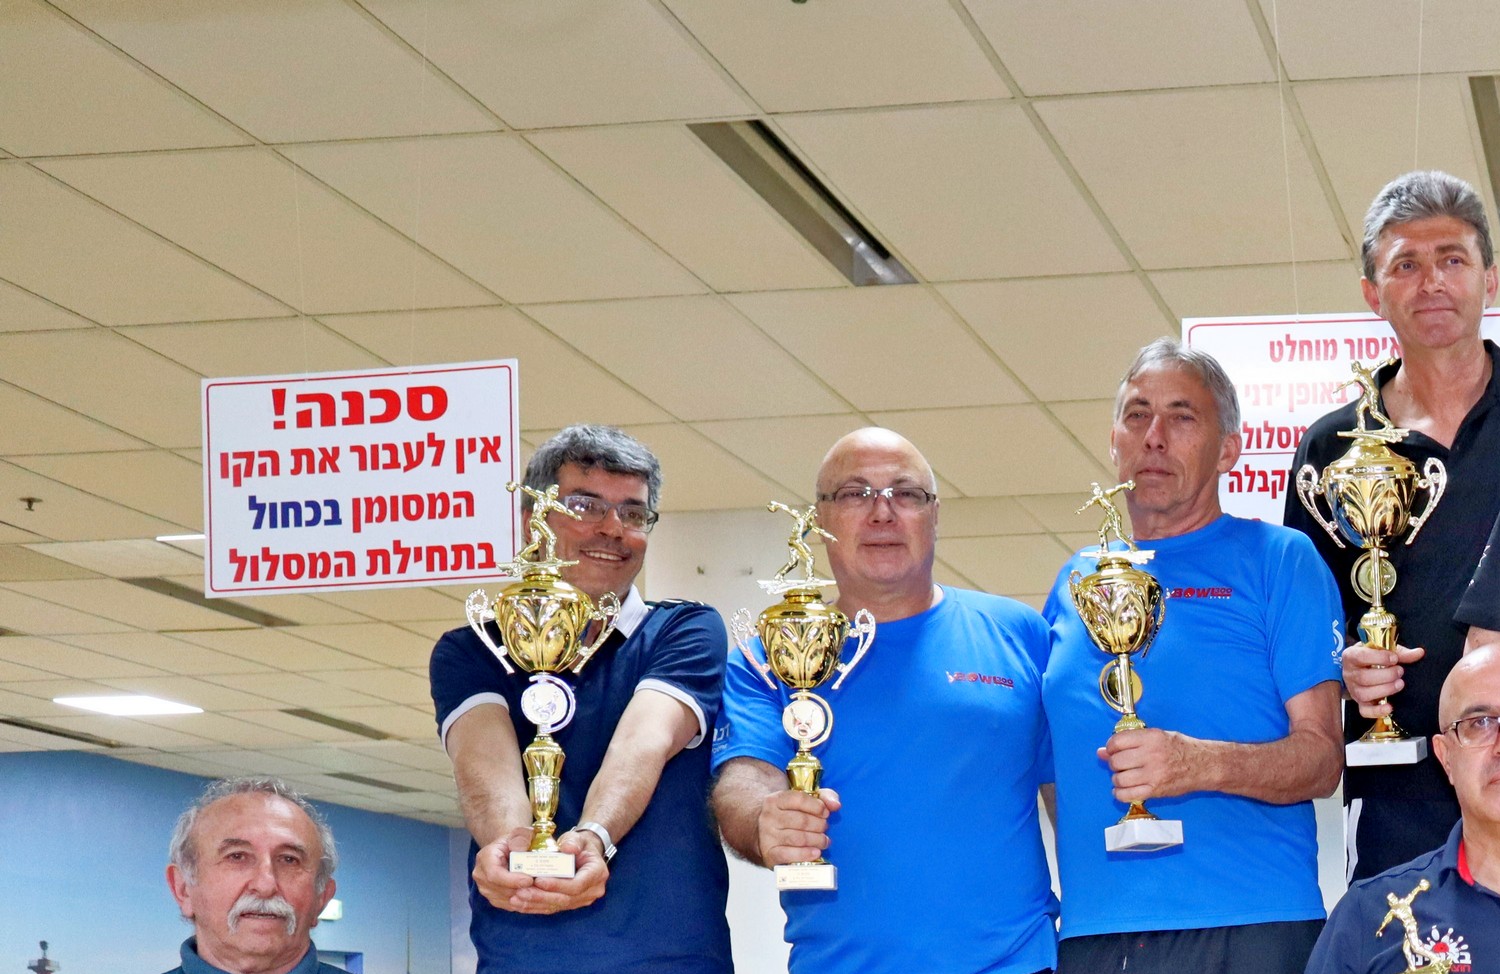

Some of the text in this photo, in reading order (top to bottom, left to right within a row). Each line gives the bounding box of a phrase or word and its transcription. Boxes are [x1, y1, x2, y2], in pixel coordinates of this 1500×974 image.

[1269, 334, 1338, 363] מוחלט
[271, 385, 449, 430] סכנה!
[219, 432, 502, 487] אין לעבור את הקו
[1228, 464, 1292, 499] קבלה
[248, 490, 475, 533] המסומן בכחול
[228, 540, 496, 583] בתחילת המסלול
